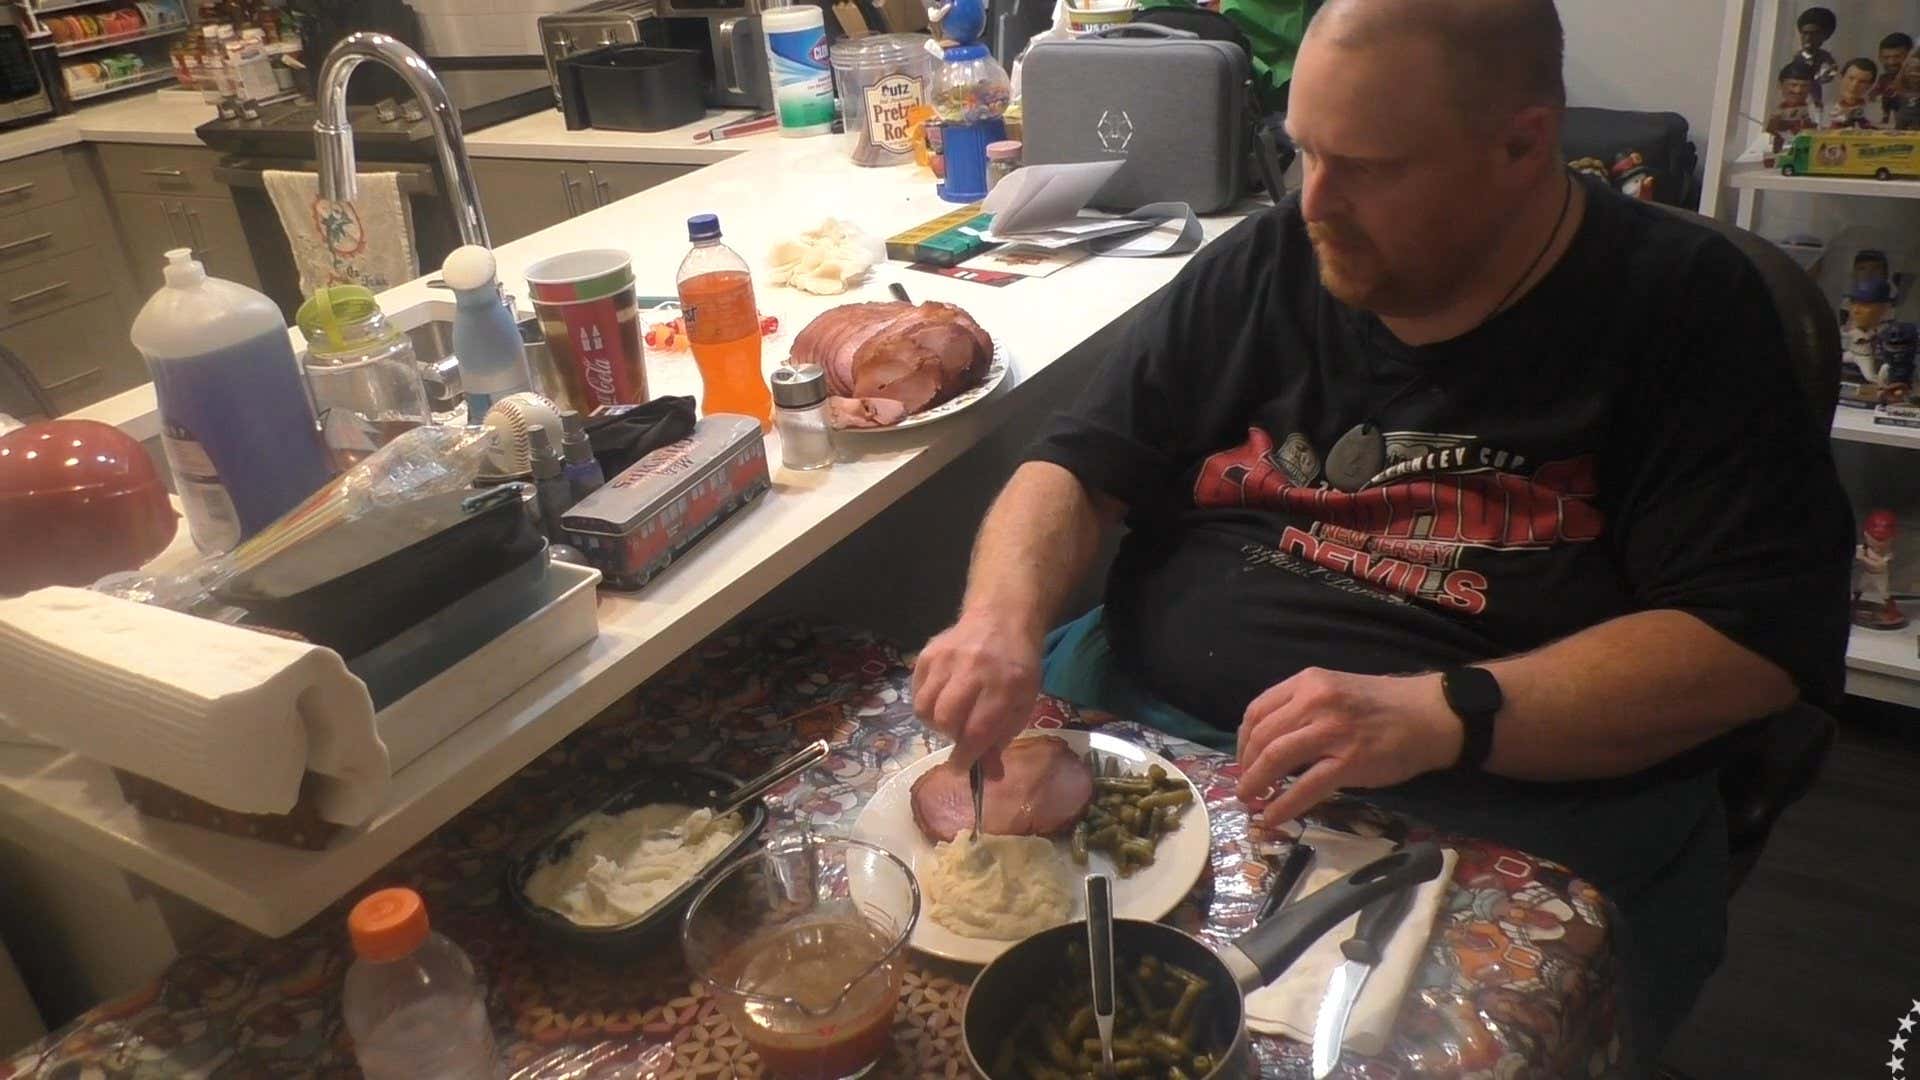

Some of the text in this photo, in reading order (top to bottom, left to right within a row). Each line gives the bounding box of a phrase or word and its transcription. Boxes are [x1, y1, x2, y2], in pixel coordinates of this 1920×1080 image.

[1479, 447, 1525, 469] CUP
[1320, 522, 1457, 569] NEW JERSEY
[1279, 524, 1488, 615] DEVILS
